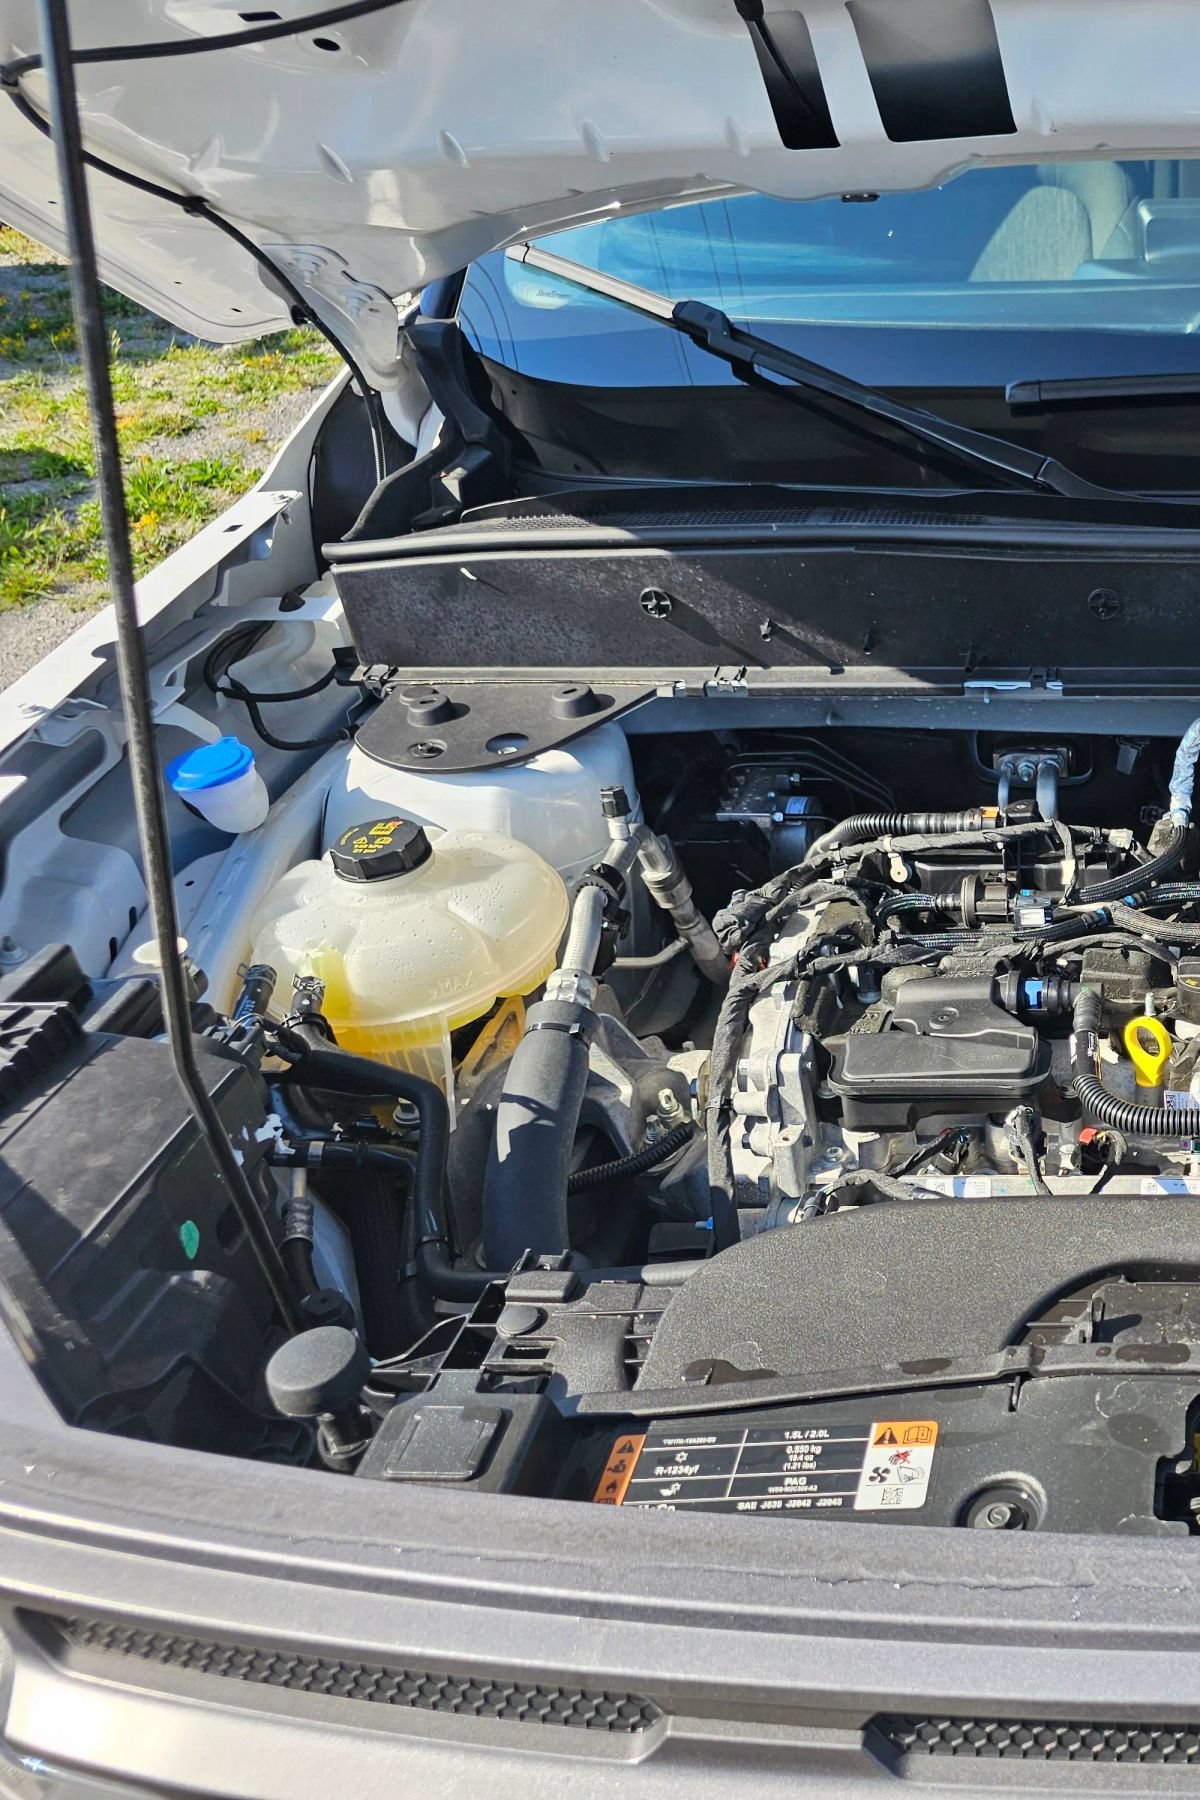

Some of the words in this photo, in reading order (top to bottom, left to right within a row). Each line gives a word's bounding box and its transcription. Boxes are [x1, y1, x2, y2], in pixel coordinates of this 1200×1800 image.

[785, 1430, 803, 1439] 1.5L
[809, 1429, 829, 1437] 2.0L
[810, 1445, 821, 1454] kg
[655, 1465, 699, 1475] R-1234yf
[784, 1477, 806, 1485] PAG
[737, 1502, 757, 1510] SAE
